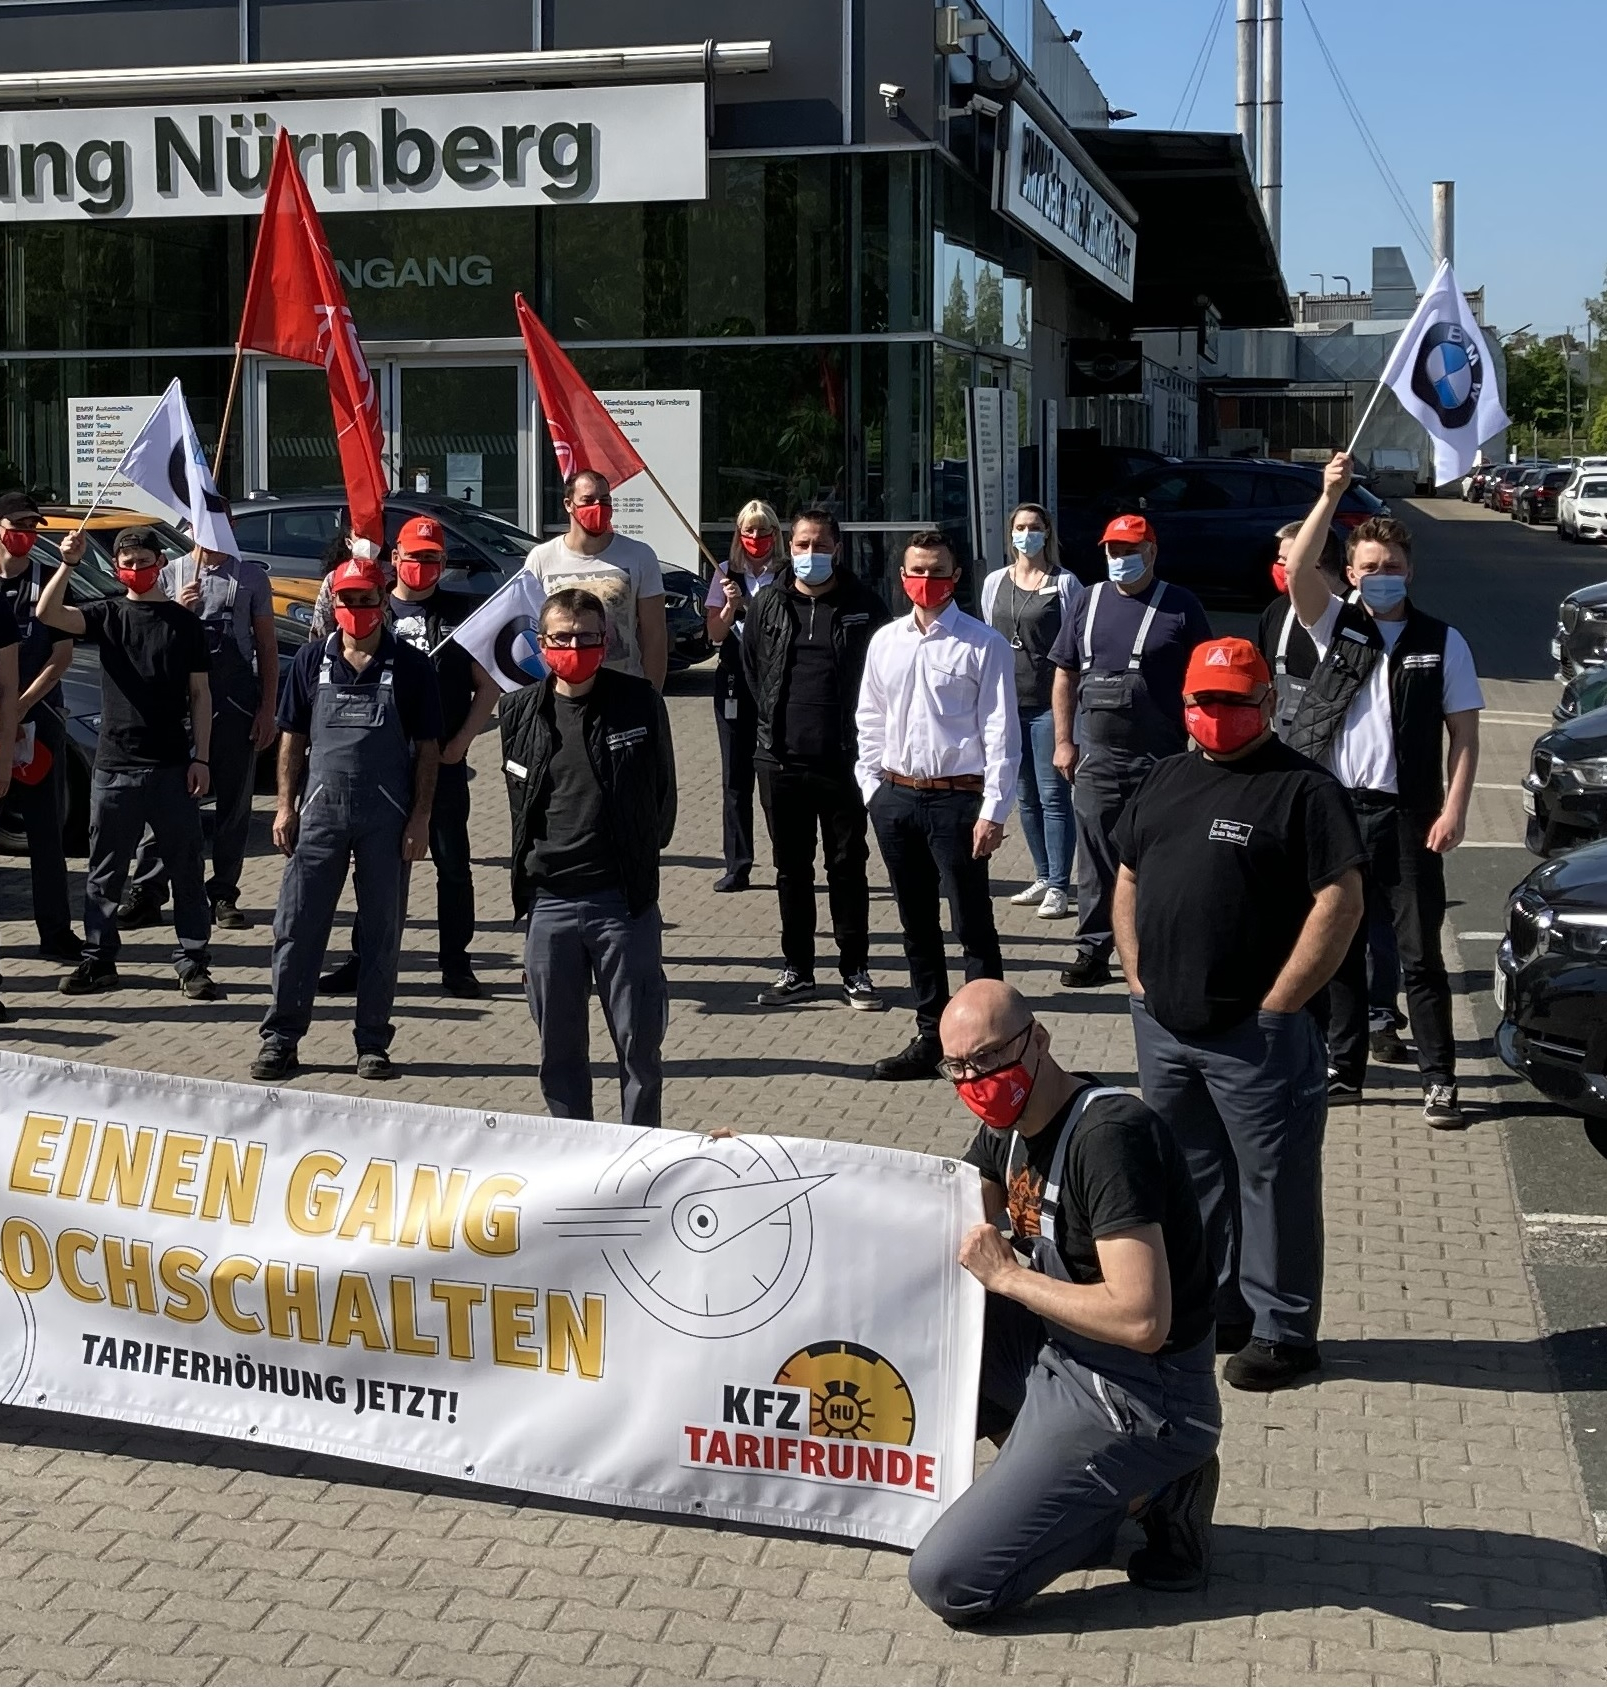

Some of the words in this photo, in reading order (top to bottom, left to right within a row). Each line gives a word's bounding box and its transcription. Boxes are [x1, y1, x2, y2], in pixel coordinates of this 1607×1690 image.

[336, 254, 492, 289] NGANG
[1447, 325, 1482, 400] BMW
[8, 1110, 268, 1225] EINEN
[286, 1149, 528, 1258] GANG
[81, 1333, 347, 1405] TARIFERHÖHUNG
[354, 1378, 460, 1425] JETZT!
[723, 1384, 801, 1431] KFZ
[829, 1403, 855, 1421] HU
[684, 1425, 936, 1493] TARIFRUNDE
